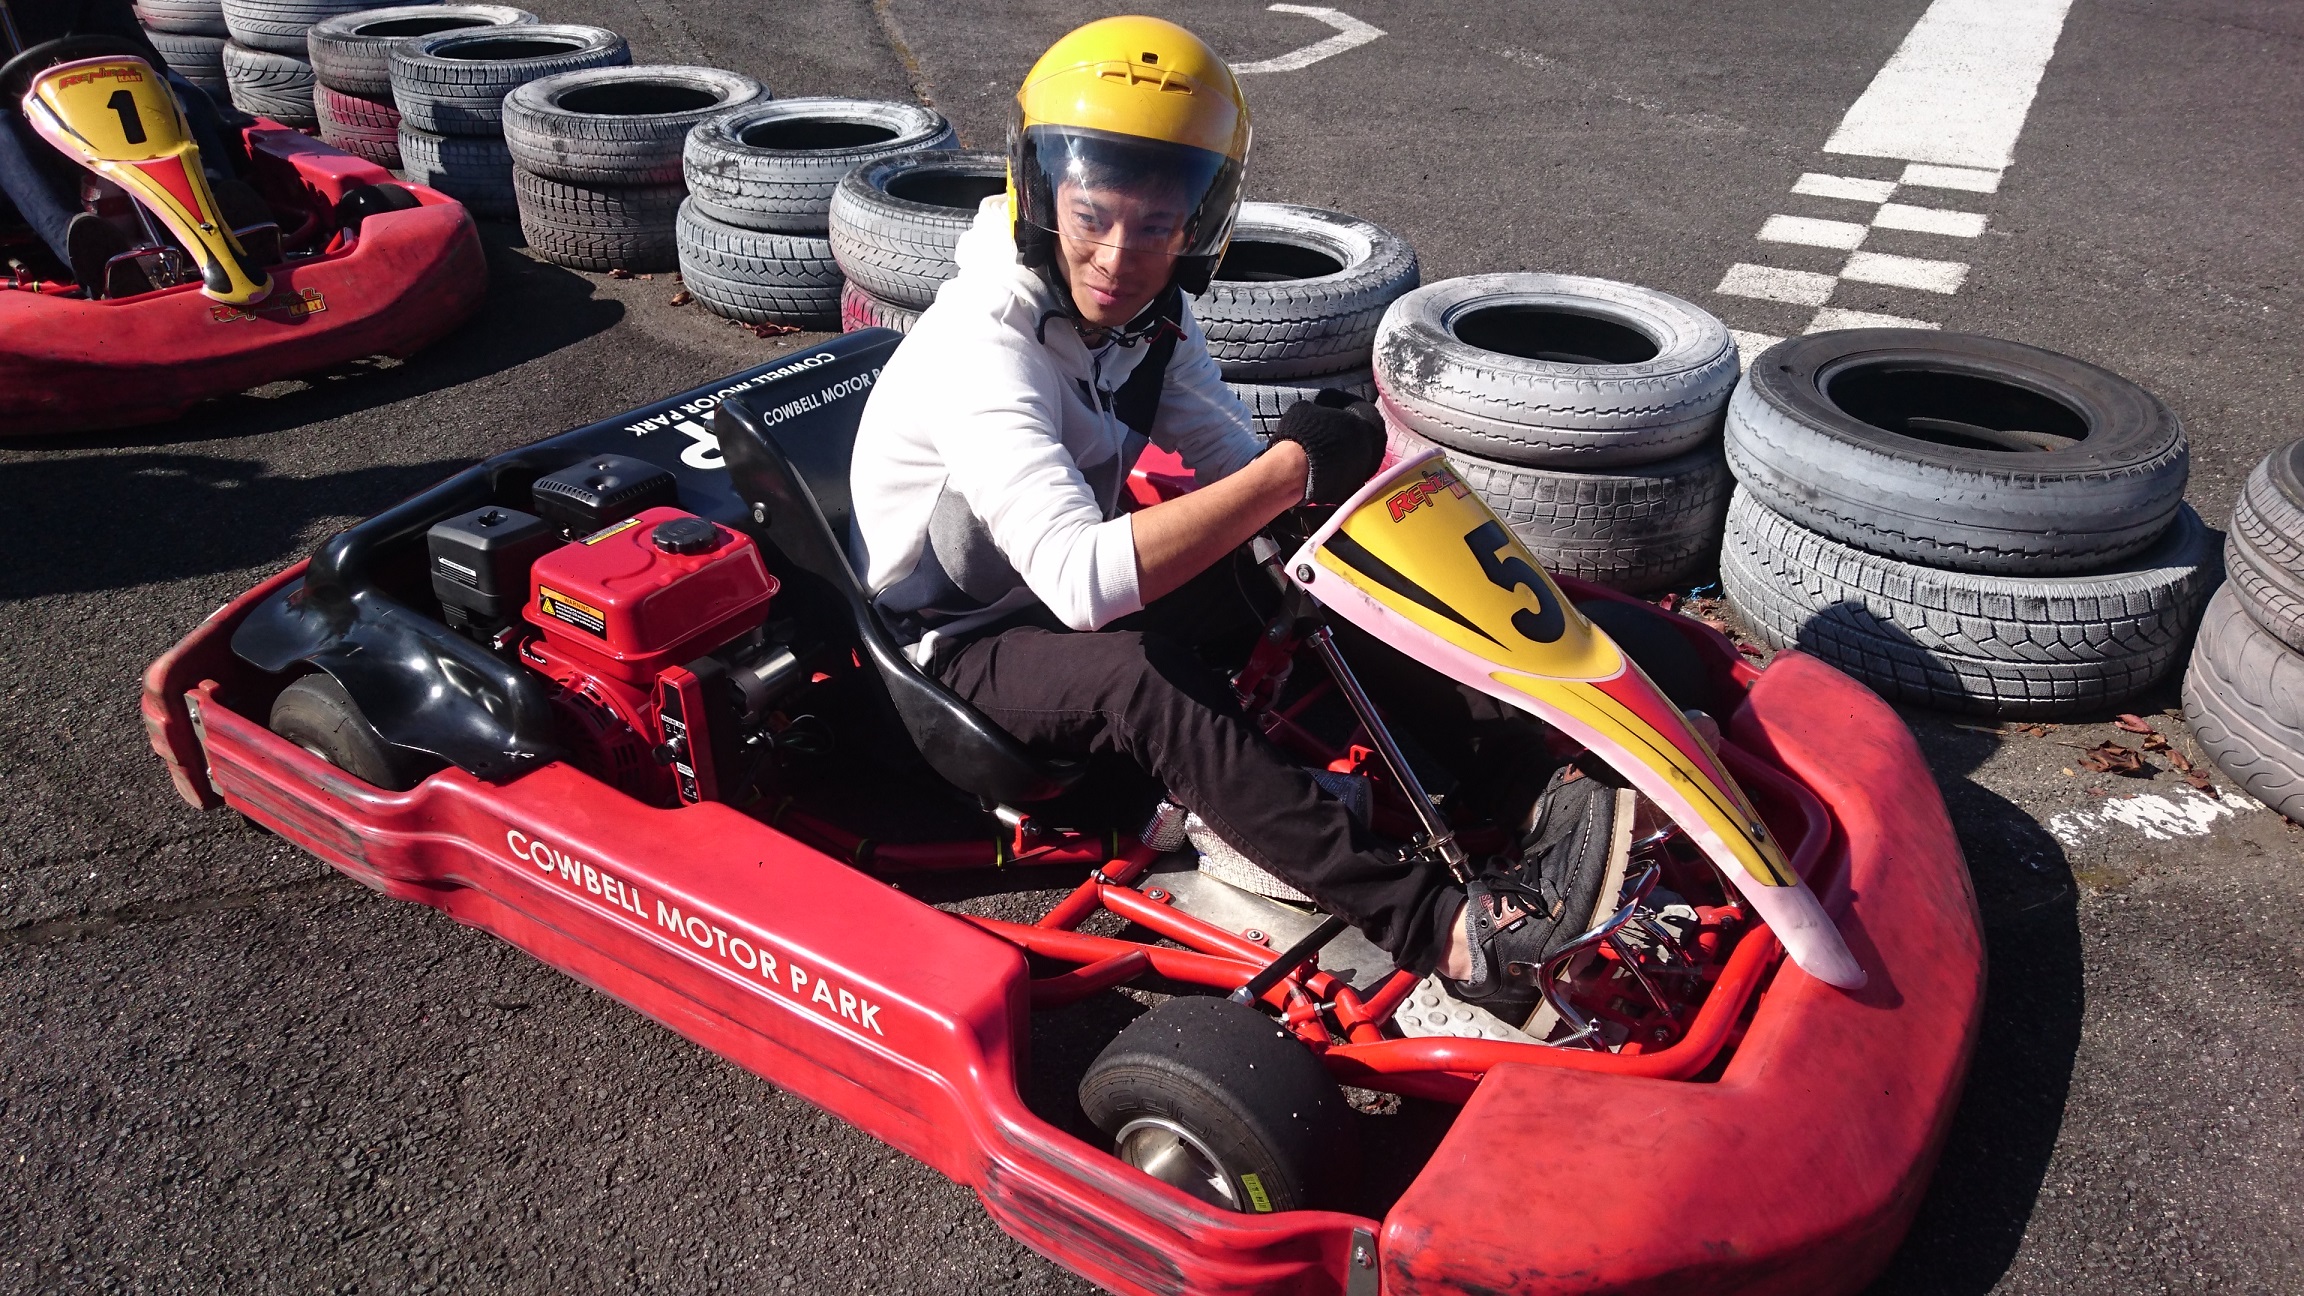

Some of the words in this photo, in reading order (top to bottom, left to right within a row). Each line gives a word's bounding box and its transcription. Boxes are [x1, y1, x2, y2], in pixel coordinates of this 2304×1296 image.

[107, 90, 147, 144] 1
[290, 299, 323, 317] KART
[624, 410, 685, 437] PARK
[763, 393, 821, 426] COWBELL
[822, 373, 872, 404] MOTOR
[1386, 469, 1459, 523] RENTA
[563, 597, 590, 613] WARNING
[1464, 520, 1565, 643] 5
[507, 830, 648, 919] COWBELL
[657, 900, 780, 984] MOTOR
[790, 963, 884, 1036] PARK
